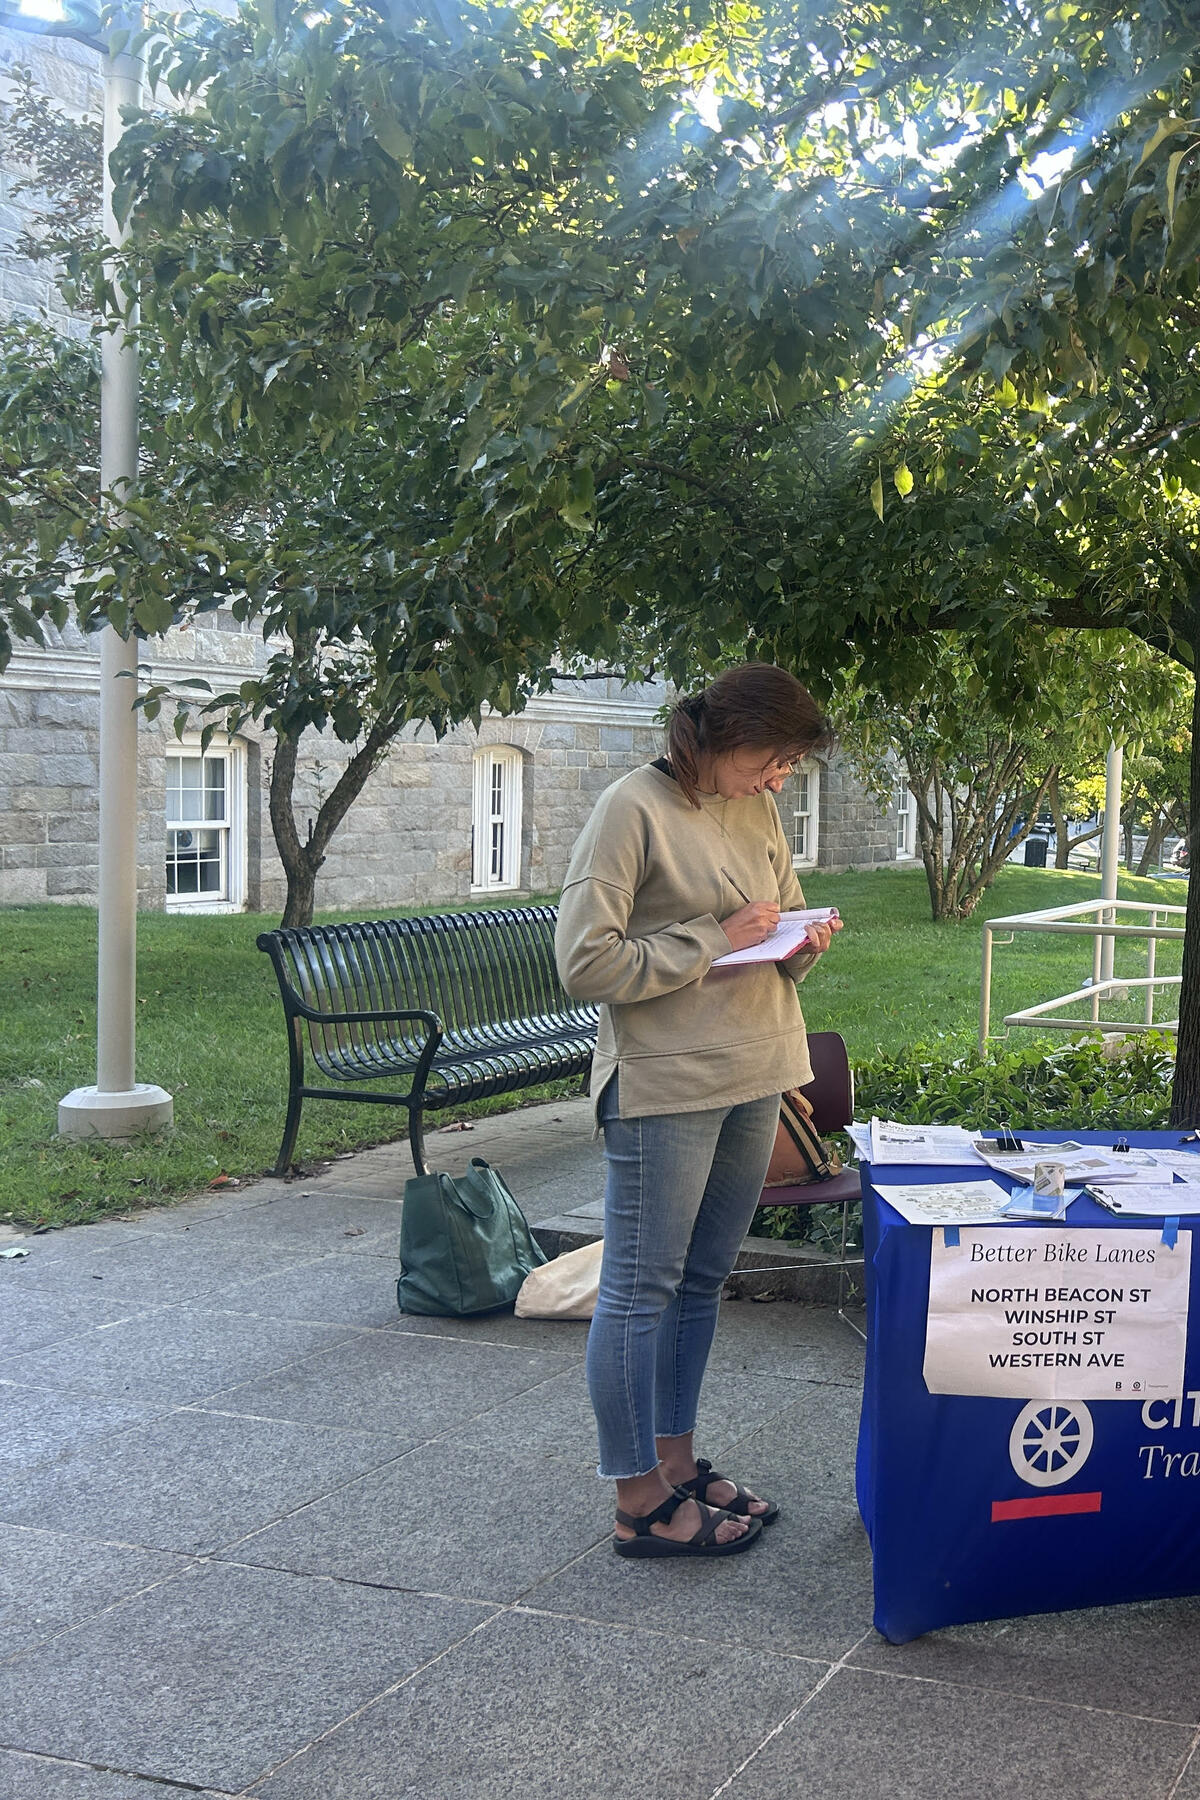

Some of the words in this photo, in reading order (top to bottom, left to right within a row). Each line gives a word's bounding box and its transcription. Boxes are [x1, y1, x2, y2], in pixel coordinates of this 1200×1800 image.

[970, 1243, 1037, 1262] Better
[1043, 1243, 1088, 1262] Bike
[1095, 1244, 1156, 1263] Lanes
[971, 1288, 1039, 1303] NORTH
[1044, 1288, 1124, 1302] BEACON
[1129, 1288, 1151, 1303] ST
[1004, 1310, 1089, 1324] WINSHIP
[1093, 1310, 1117, 1324] ST
[1012, 1331, 1077, 1346] SOUTH
[1082, 1331, 1105, 1345] ST
[989, 1353, 1082, 1368] WESTERN
[1087, 1353, 1125, 1367] AVE
